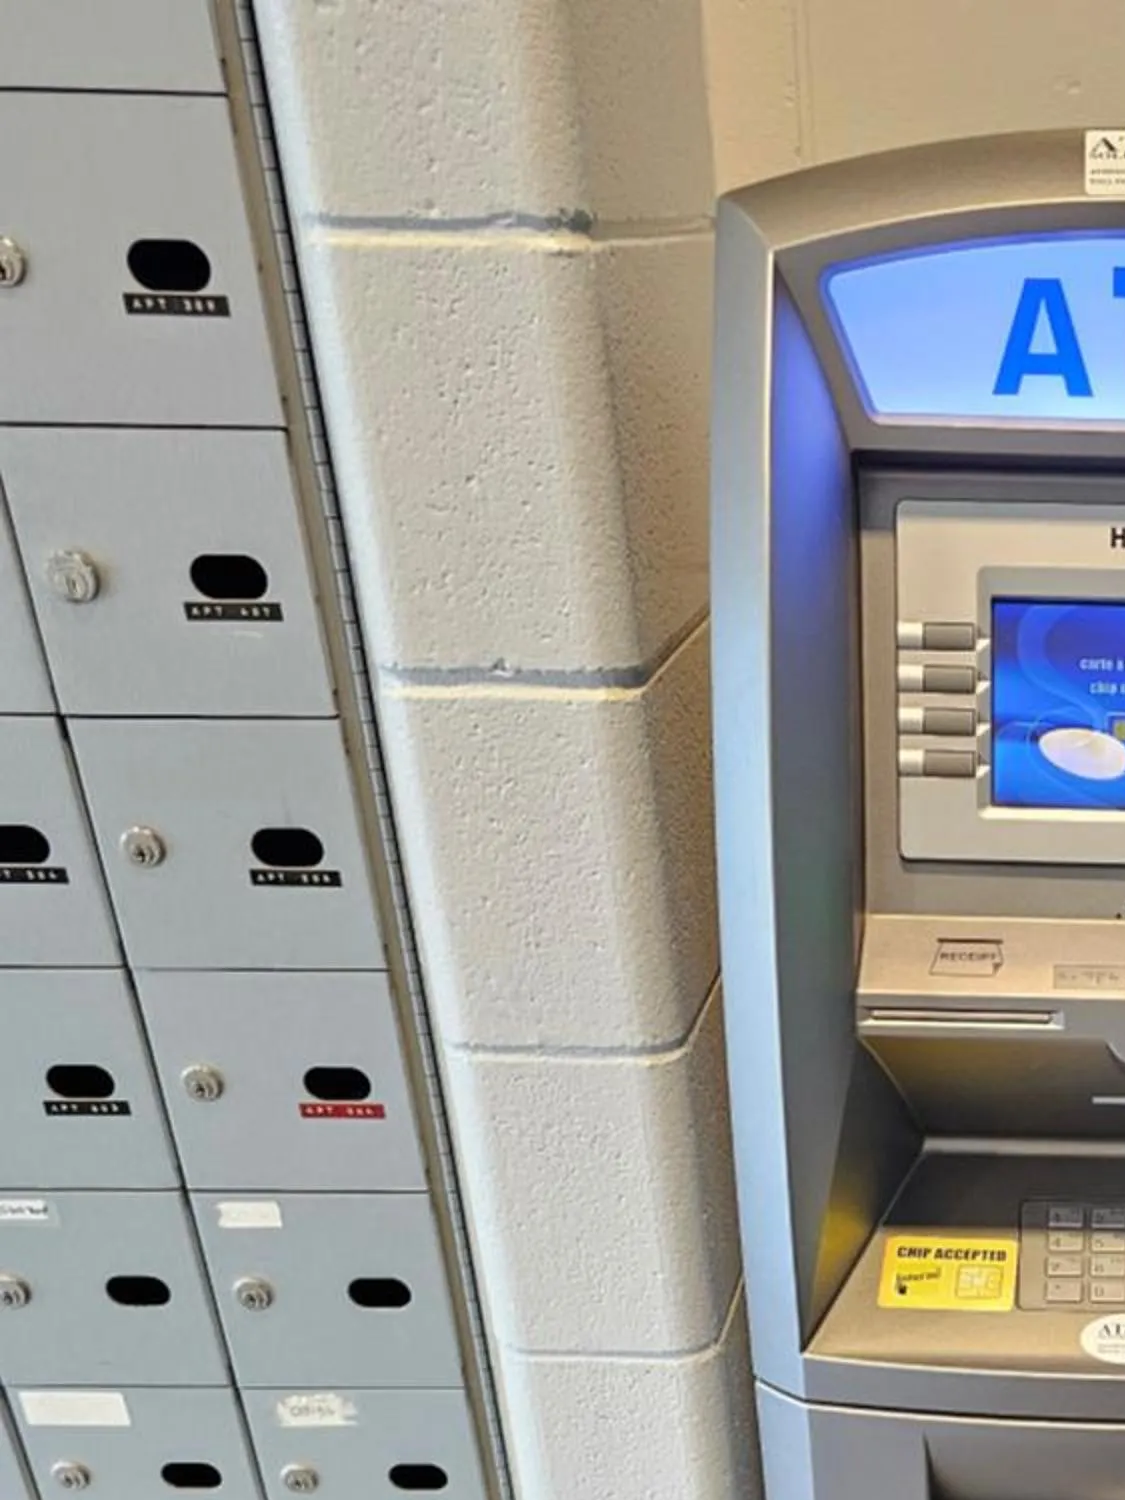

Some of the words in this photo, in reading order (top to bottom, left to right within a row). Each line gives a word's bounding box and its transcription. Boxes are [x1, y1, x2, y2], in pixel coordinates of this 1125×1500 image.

[940, 952, 996, 961] RECEIPT
[897, 1246, 932, 1259] CHIP
[934, 1247, 1007, 1262] ACCEPTED
